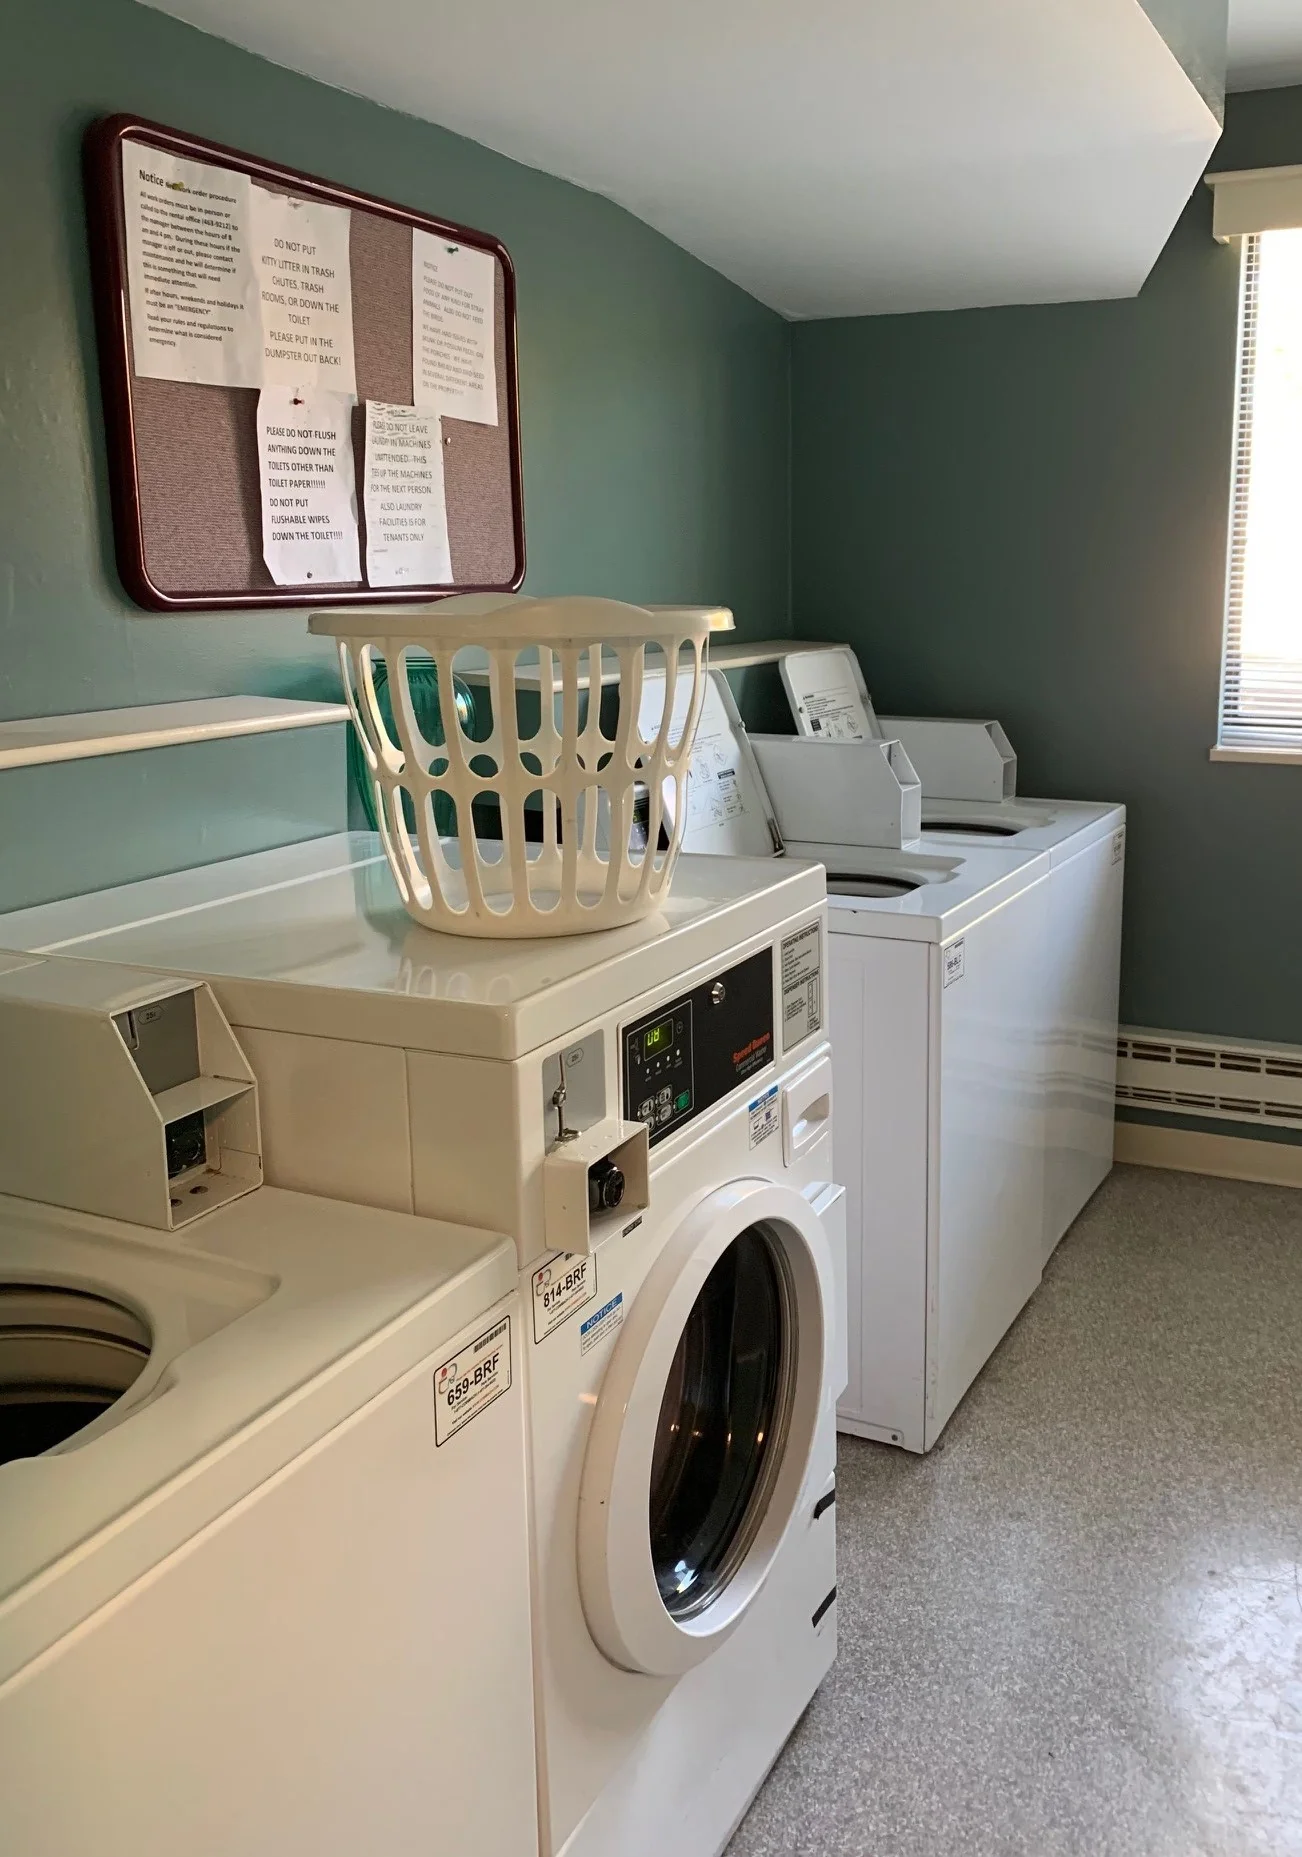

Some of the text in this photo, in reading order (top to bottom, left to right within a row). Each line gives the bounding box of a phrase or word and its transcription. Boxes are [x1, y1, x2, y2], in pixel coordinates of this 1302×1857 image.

[139, 169, 164, 186] Notice
[209, 192, 236, 203] procedure
[175, 202, 188, 210] must
[204, 208, 223, 217] person
[186, 215, 200, 223] office
[171, 223, 193, 233] between
[205, 230, 220, 239] hours
[175, 235, 193, 245] During
[194, 239, 208, 247] these
[209, 242, 225, 251] hours
[274, 238, 316, 256] DO NOT PUT
[213, 254, 234, 263] contact
[262, 255, 335, 278] KITTY LITTER IN TRASH
[272, 276, 324, 294] CHUTES, TRASH
[288, 296, 298, 307] OR
[299, 298, 324, 311] DOWN
[325, 302, 340, 313] THE
[288, 313, 310, 326] TOILET
[270, 330, 333, 348] PLEASE PUT IN THE
[265, 348, 341, 365] DUMPSTER OUT BACK!
[266, 426, 336, 440] PLEASE DO NOT FLUSH
[395, 423, 407, 432] NOT
[409, 424, 428, 434] LEAVE
[390, 437, 431, 449] IN MACHINES
[267, 444, 336, 456] ANYTHING DOWN THE
[413, 455, 427, 464] THIS
[268, 461, 334, 472] TOILETS OTHER THAN
[387, 469, 399, 478] THE
[400, 470, 432, 479] MACHINES
[269, 478, 288, 488] TOILET
[370, 484, 379, 492] FOR
[380, 484, 391, 493] THE
[392, 485, 406, 493] NEXT
[269, 498, 309, 507] DO NOT PUT
[396, 503, 422, 511] LAUNDRY
[271, 515, 330, 524] FLUSHABLE WIPES
[379, 518, 407, 526] FACILITIES
[414, 518, 426, 526] FOR
[272, 532, 294, 540] DOWN
[296, 532, 309, 540] THE
[383, 533, 424, 542] TENANTS ONLY
[544, 1262, 587, 1308] 814-BRF
[587, 1298, 617, 1329] NOTICE
[447, 1352, 500, 1406] 659-BRF
